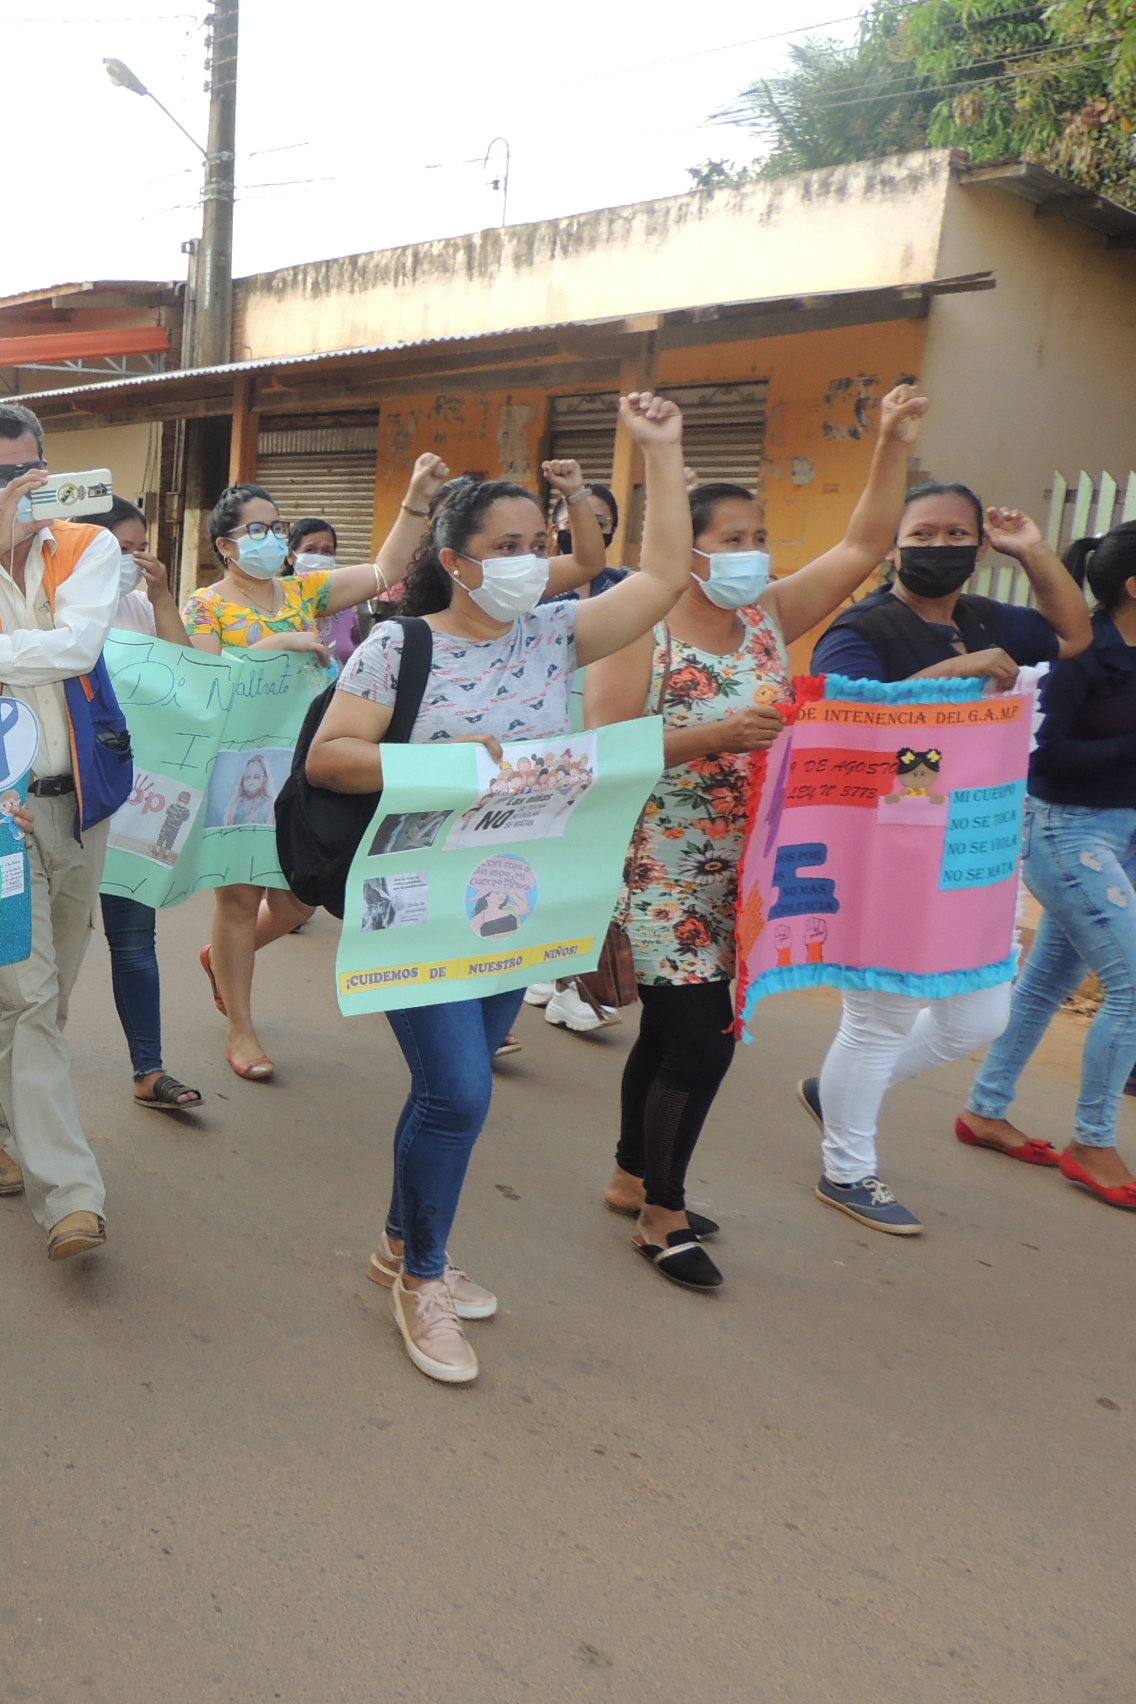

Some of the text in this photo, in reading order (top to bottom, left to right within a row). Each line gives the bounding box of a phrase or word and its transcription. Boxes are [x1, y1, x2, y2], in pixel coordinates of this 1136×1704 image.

[824, 708, 927, 726] INTENENCIA
[935, 711, 965, 725] DEL
[804, 759, 900, 776] DE AGOSTO
[840, 786, 879, 799] 3773
[953, 783, 1017, 804] MI CUERPO
[473, 809, 516, 832] NO
[949, 809, 1017, 831] NO SE TOCA
[946, 842, 967, 855] NO
[969, 841, 989, 854] SE
[504, 861, 523, 871] ropa
[942, 861, 1014, 883] NO SE MATA
[344, 944, 580, 991] ¡CUIDEMOS DE NUESTRO NIÑOS!
